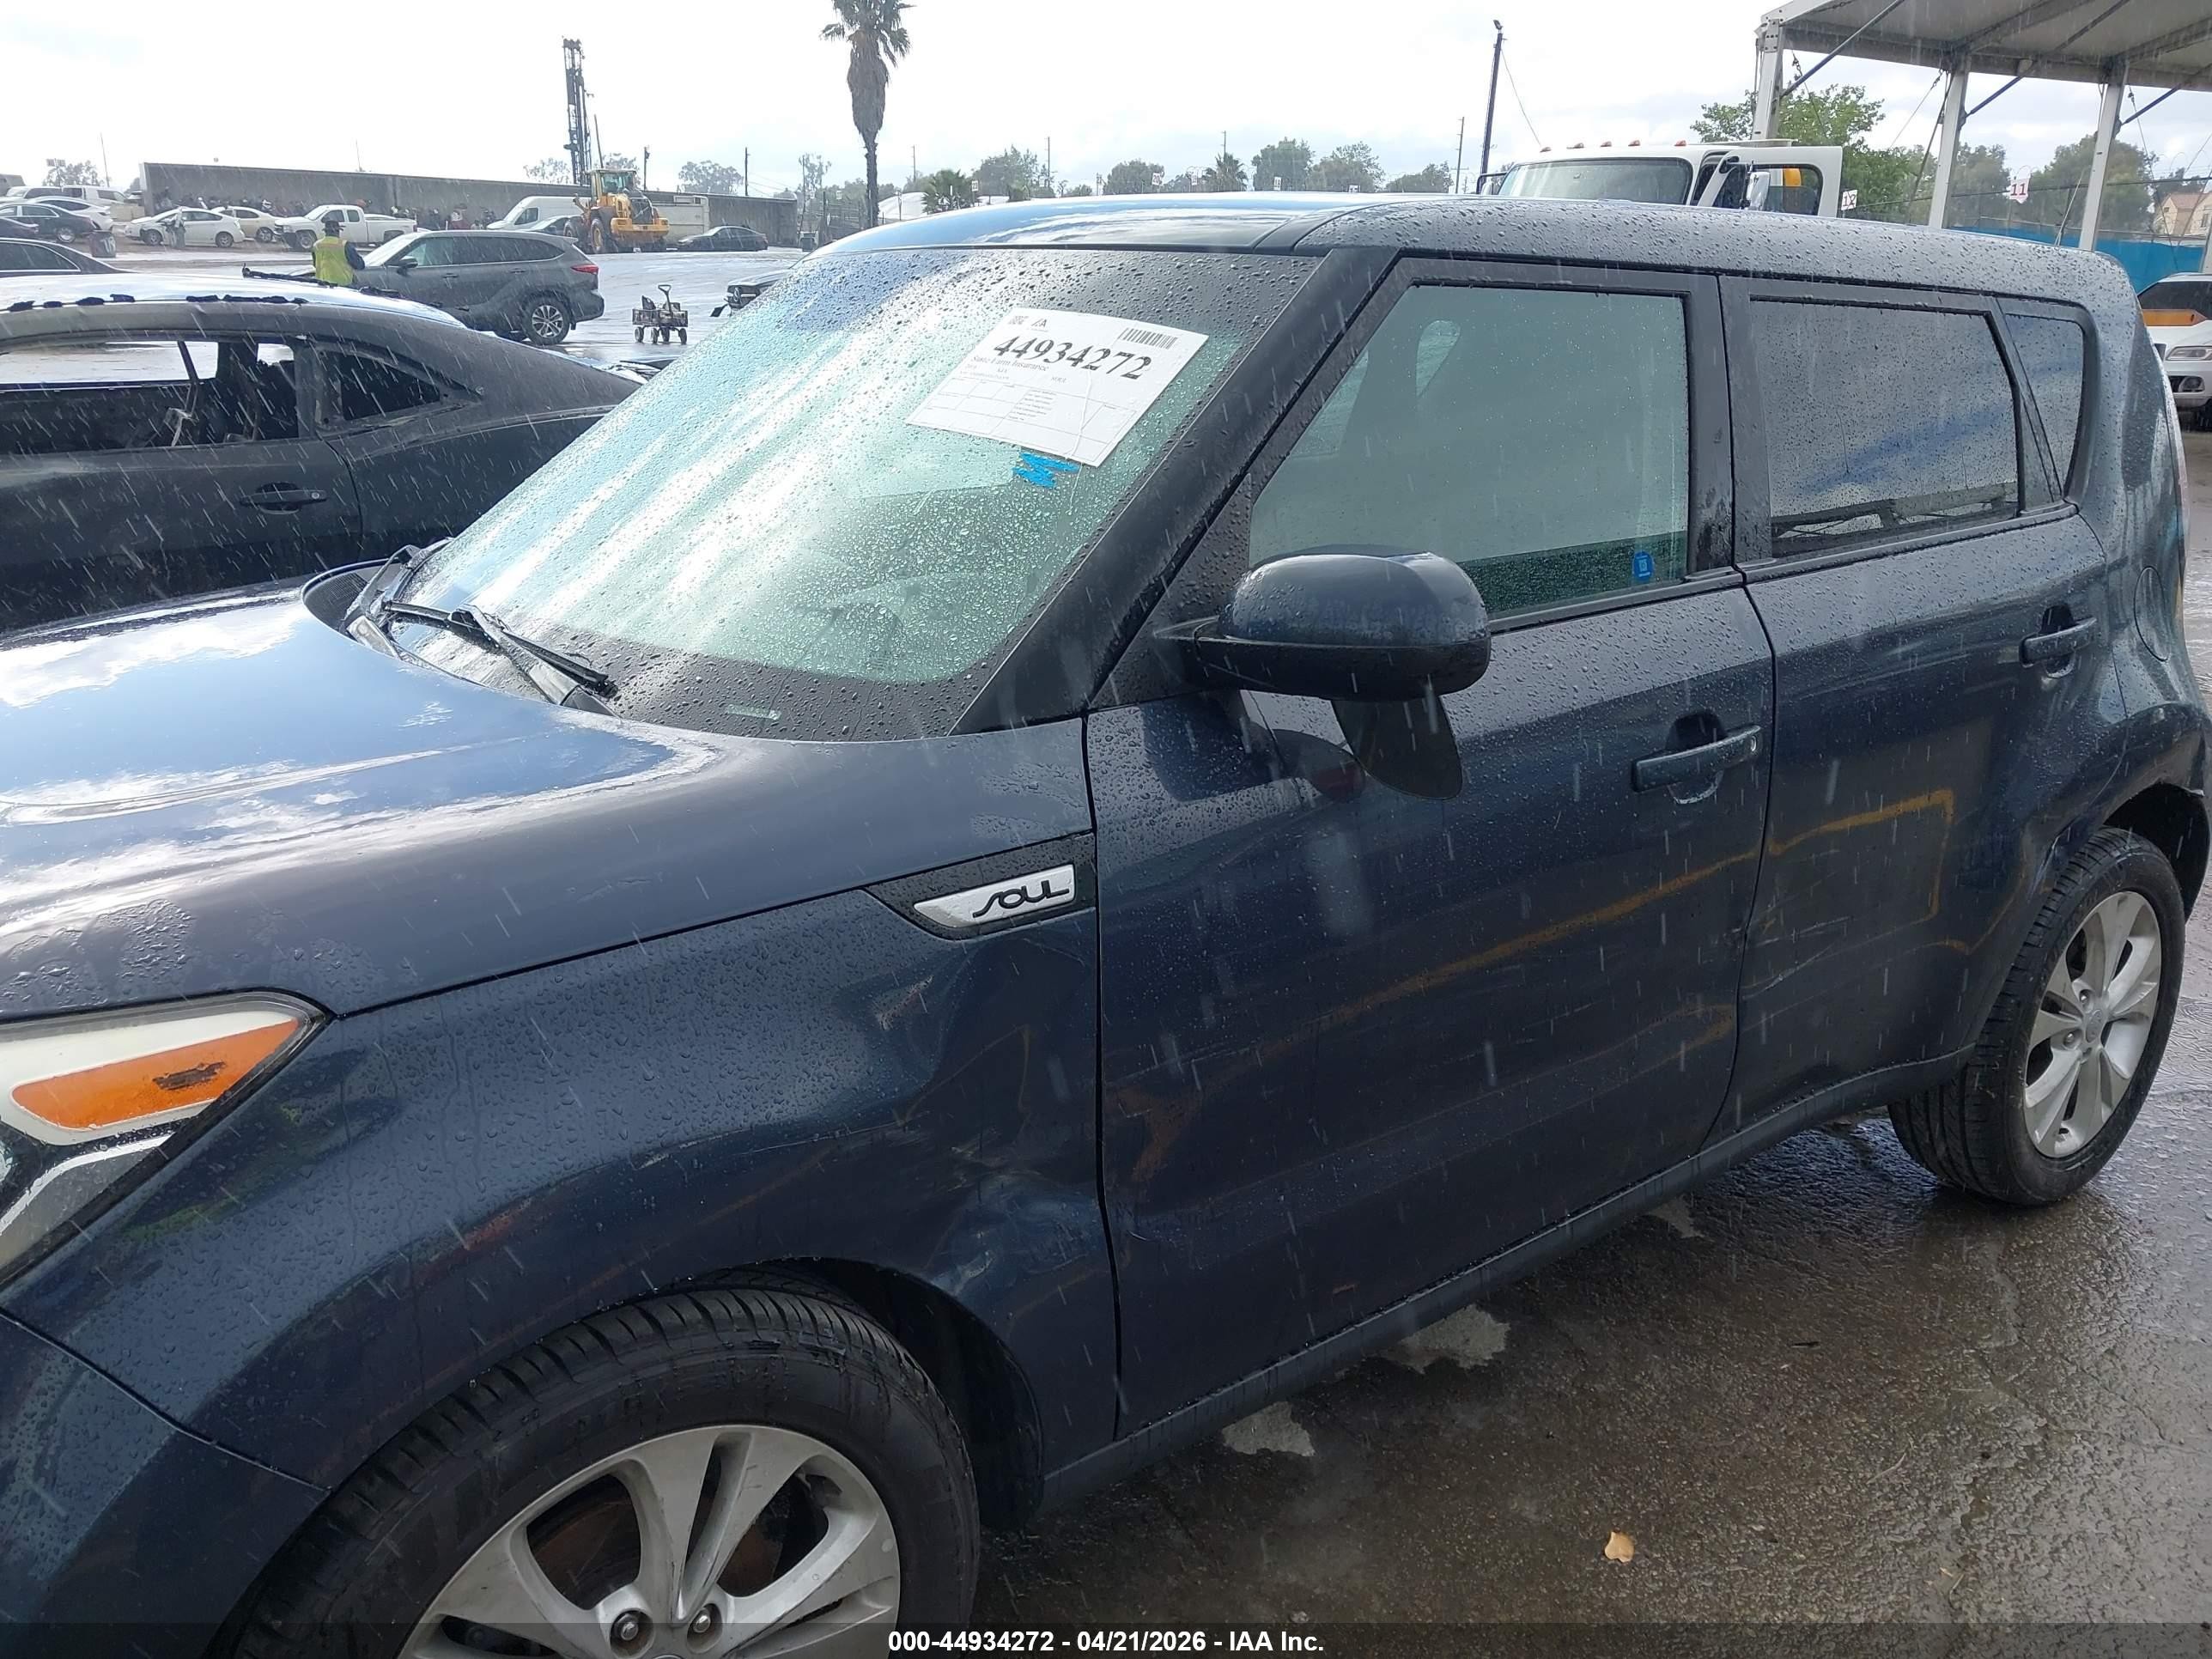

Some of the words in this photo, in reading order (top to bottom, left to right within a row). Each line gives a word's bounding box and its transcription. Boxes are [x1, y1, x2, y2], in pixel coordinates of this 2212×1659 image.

[2010, 183, 2027, 196] 11
[993, 336, 1152, 380] 44934272
[972, 879, 1070, 918] SOUL
